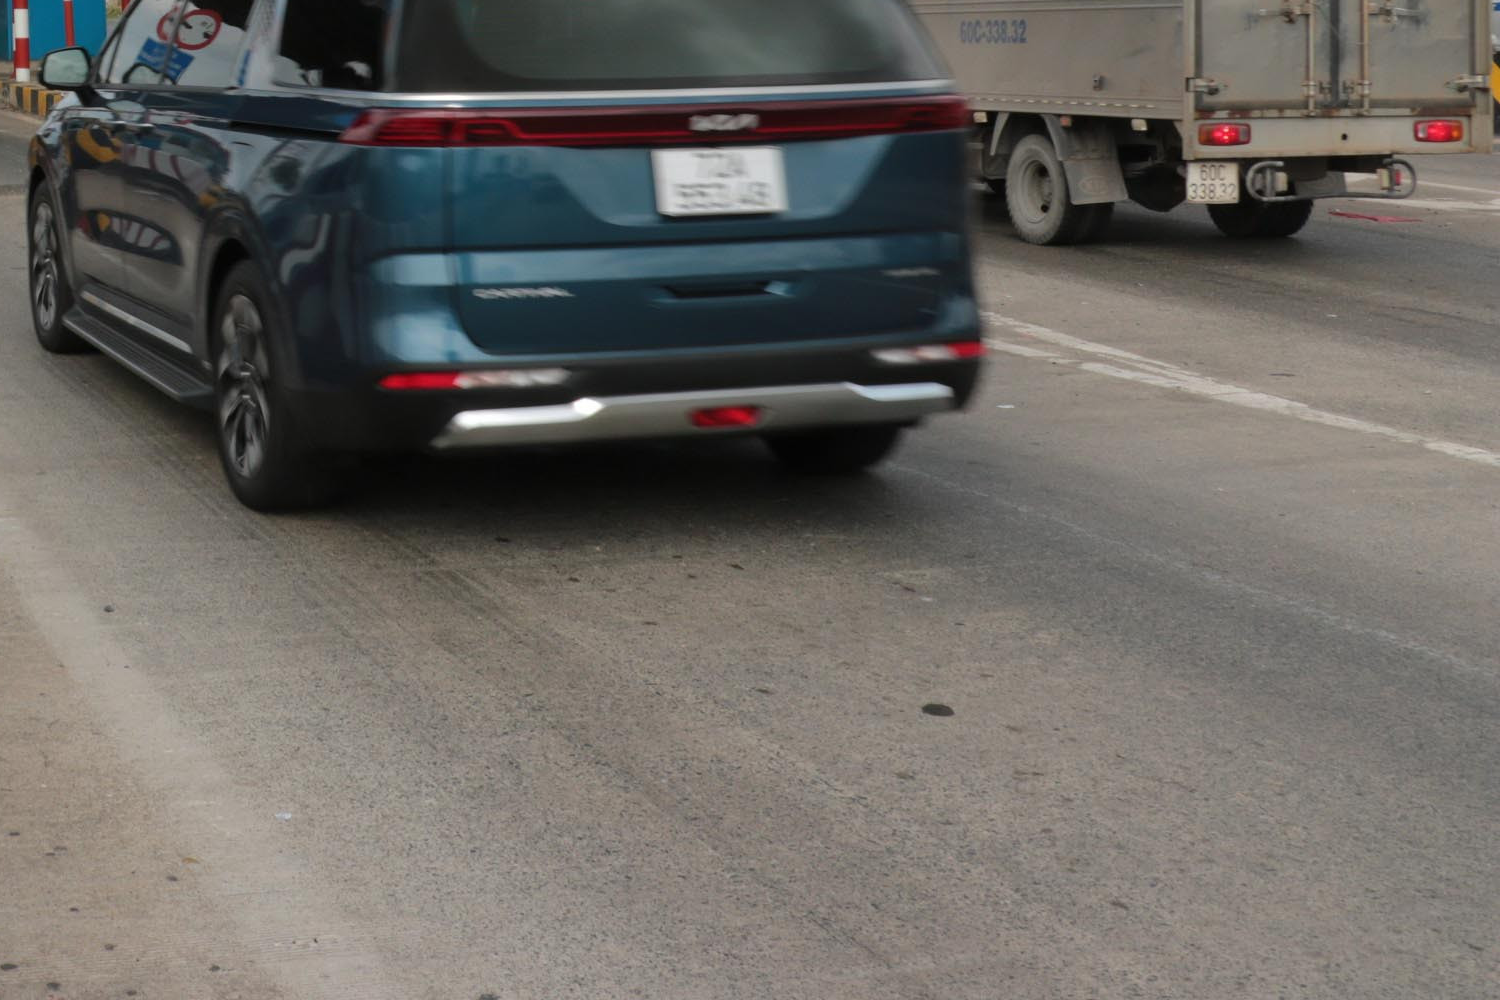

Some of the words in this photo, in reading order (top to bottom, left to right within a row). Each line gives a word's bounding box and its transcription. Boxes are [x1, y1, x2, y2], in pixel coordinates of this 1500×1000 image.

[960, 18, 1028, 44] 60C-338.32
[1200, 164, 1227, 181] 60C
[1189, 183, 1237, 200] 338.32
